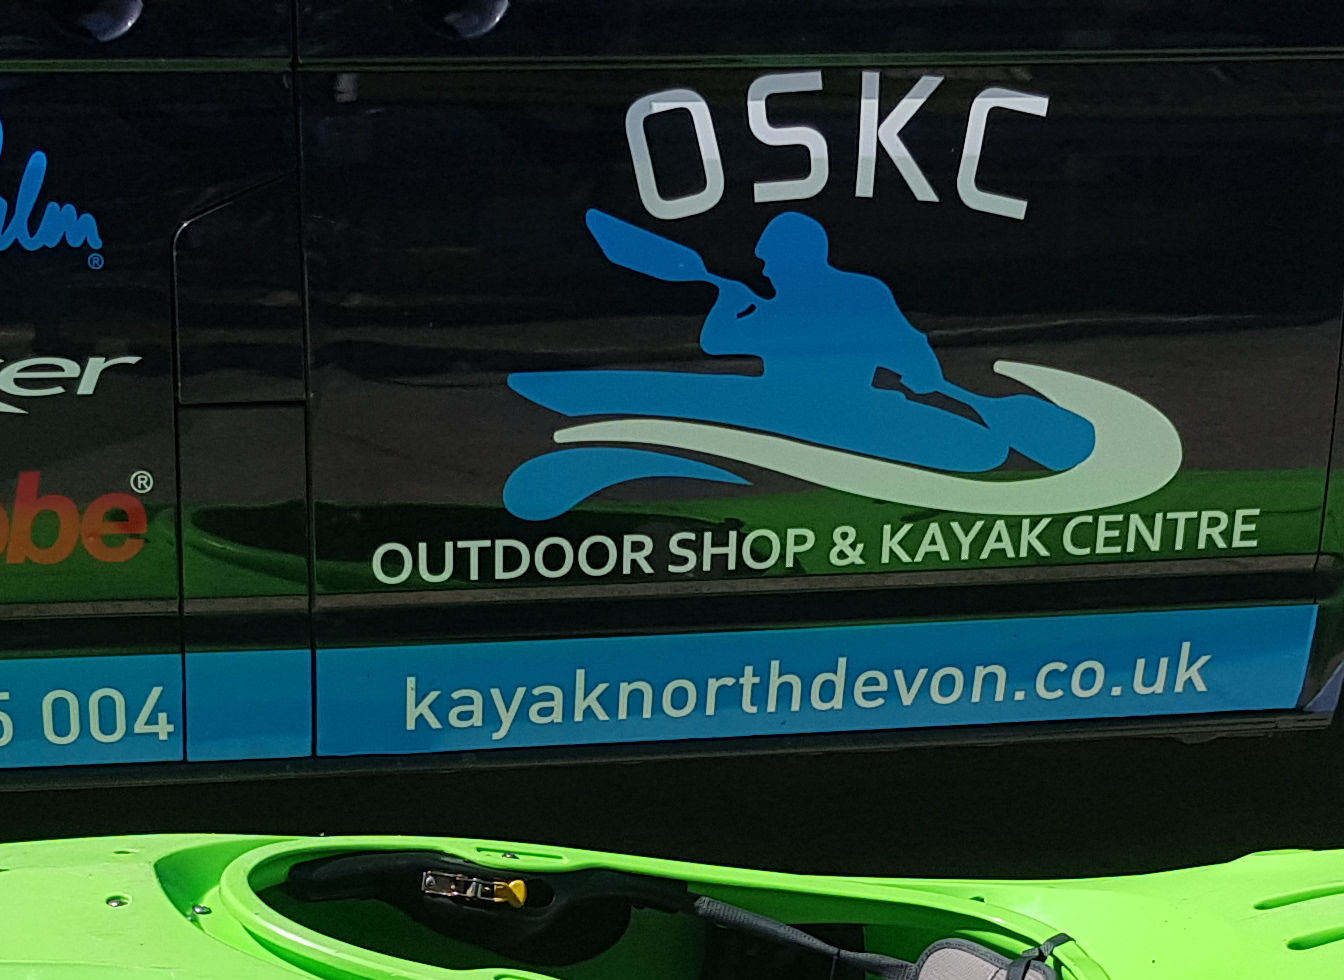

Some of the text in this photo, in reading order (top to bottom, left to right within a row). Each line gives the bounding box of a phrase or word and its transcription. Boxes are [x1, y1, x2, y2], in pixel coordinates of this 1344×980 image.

[623, 69, 1051, 221] OSKC
[370, 508, 1262, 585] OUTDOOR SHOP & KAYAK CENTRE
[41, 685, 176, 746] 004
[404, 640, 1212, 741] kayaknorthdevon.co.uk
